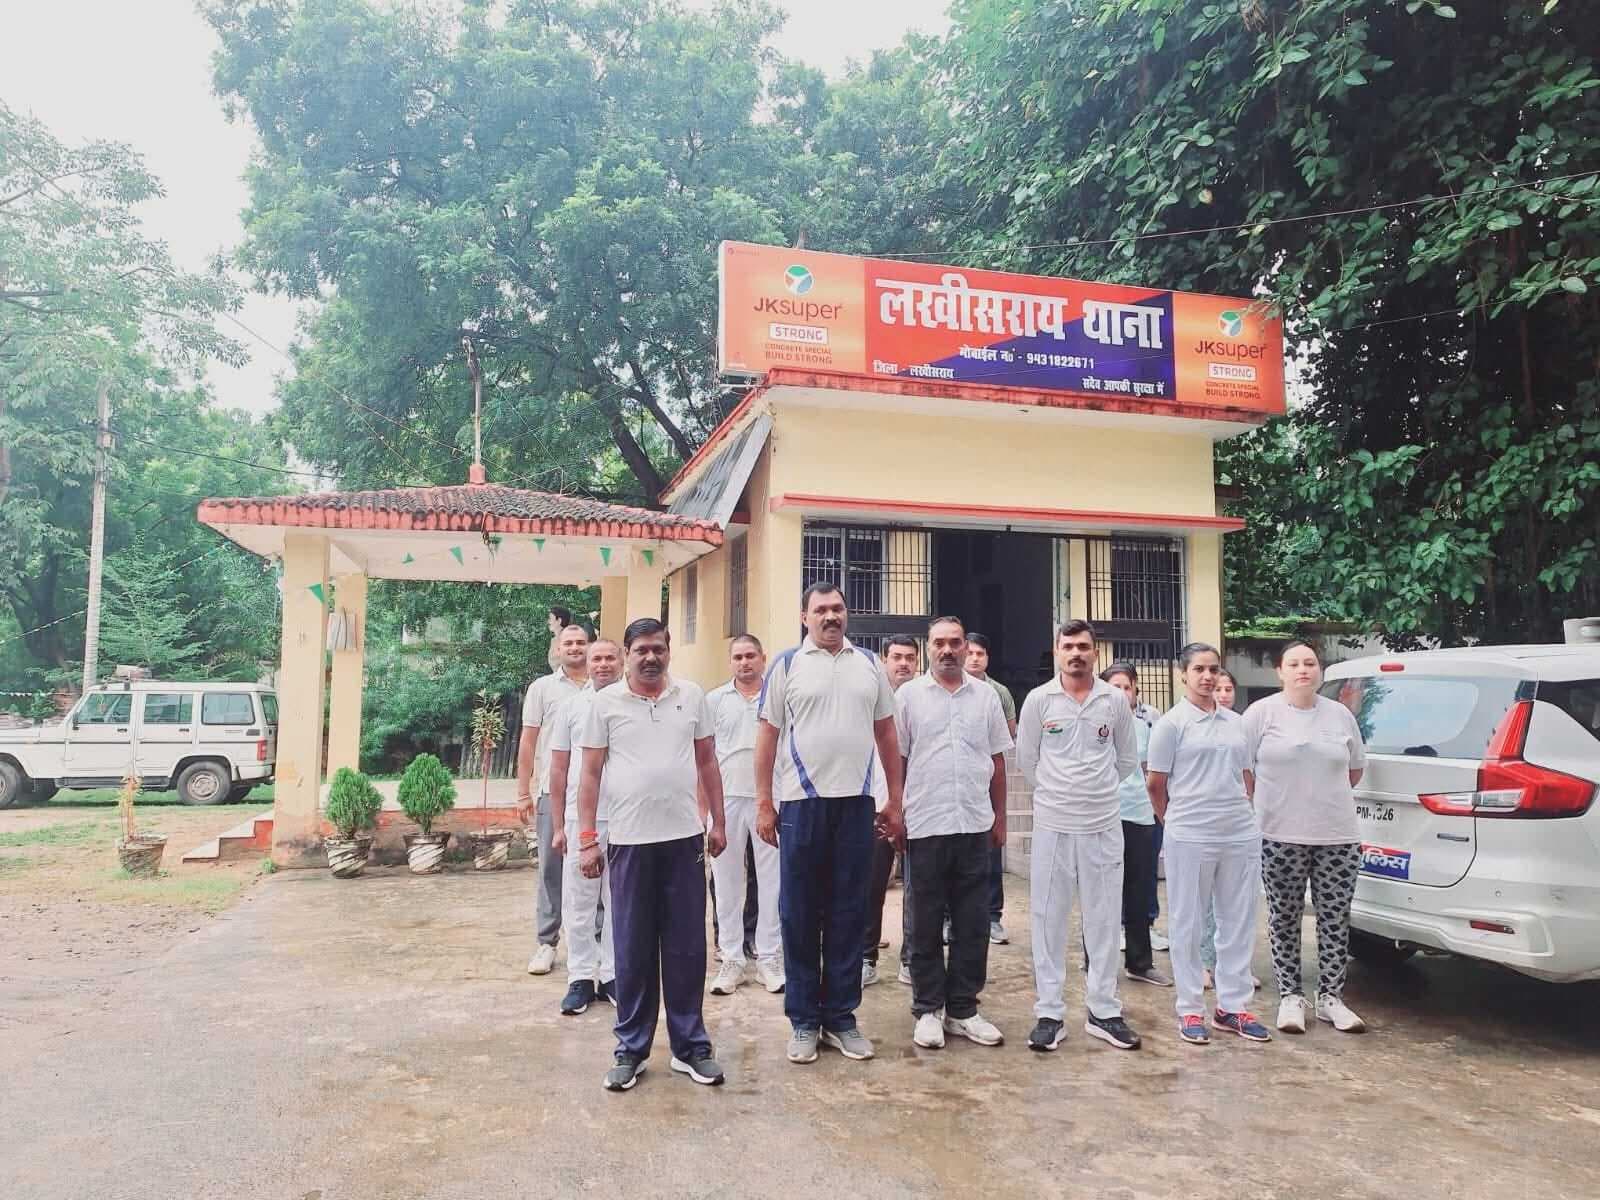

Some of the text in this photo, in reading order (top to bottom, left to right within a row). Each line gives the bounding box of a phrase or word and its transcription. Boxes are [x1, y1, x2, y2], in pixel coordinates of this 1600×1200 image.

[875, 273, 1165, 349] लखीसराय थाना
[775, 326, 823, 341] STRONG
[765, 343, 832, 355] CONCRETE SPECIAL
[765, 351, 832, 364] BUILD STRONG
[1026, 352, 1095, 369] 9431822671
[872, 359, 898, 375] जिला
[909, 363, 955, 379] लखीसराय
[1213, 366, 1252, 378] STRONG
[1104, 378, 1131, 393] आपकी
[1156, 381, 1165, 395] में
[1206, 381, 1259, 391] CONCRETE SPECIAL
[1206, 388, 1261, 399] BUILD STRONG
